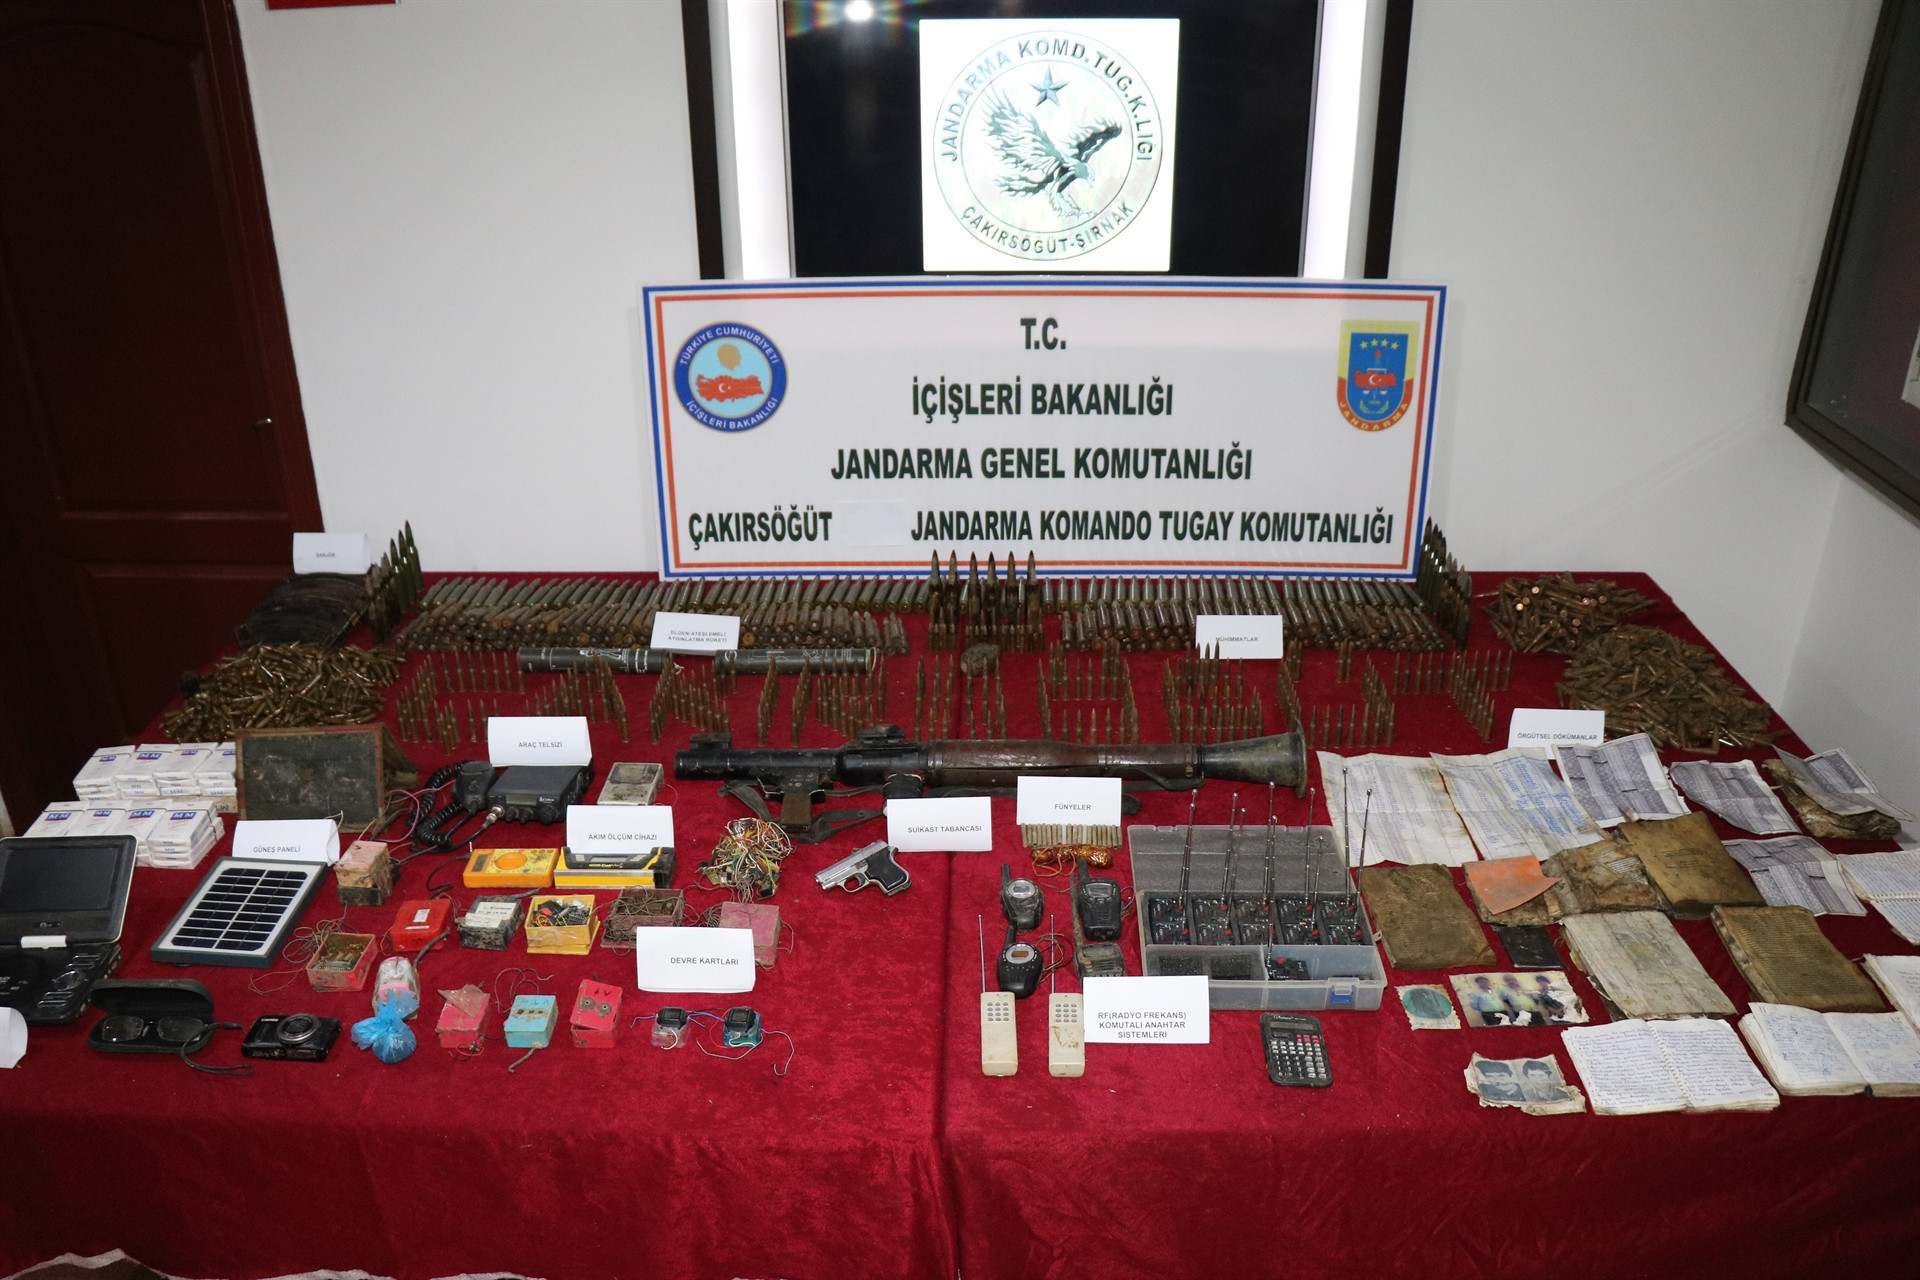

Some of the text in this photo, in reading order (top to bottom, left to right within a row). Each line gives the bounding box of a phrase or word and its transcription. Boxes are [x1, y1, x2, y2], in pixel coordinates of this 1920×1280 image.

[942, 50, 1012, 162] JANDARMA
[680, 326, 780, 365] TÜRKİYE CUMHURİYETİ
[1020, 317, 1067, 350] T.C.
[686, 397, 779, 429] İÇİŞLERİ BAKANLIĞI
[912, 375, 1174, 424] İÇİŞLERİ BAKANLIĞI
[1340, 401, 1408, 430] JANDARMA
[831, 441, 1253, 480] JANDARMA GENEL KOMUTANLIĞI
[689, 504, 833, 550] ÇAKIRSÖĞÜT
[910, 506, 1394, 545] JANDARMA KOMANDO TUGAY KOMUTANLIĞI
[607, 833, 633, 841] ÖLÇÜM
[699, 957, 739, 966] KARTLARI
[1098, 1011, 1187, 1020] RF(RADYO FREKANS)
[1099, 1021, 1186, 1029] KOMUTALI ANAHTAR
[1117, 1031, 1168, 1039] SİSTEMLERİ
